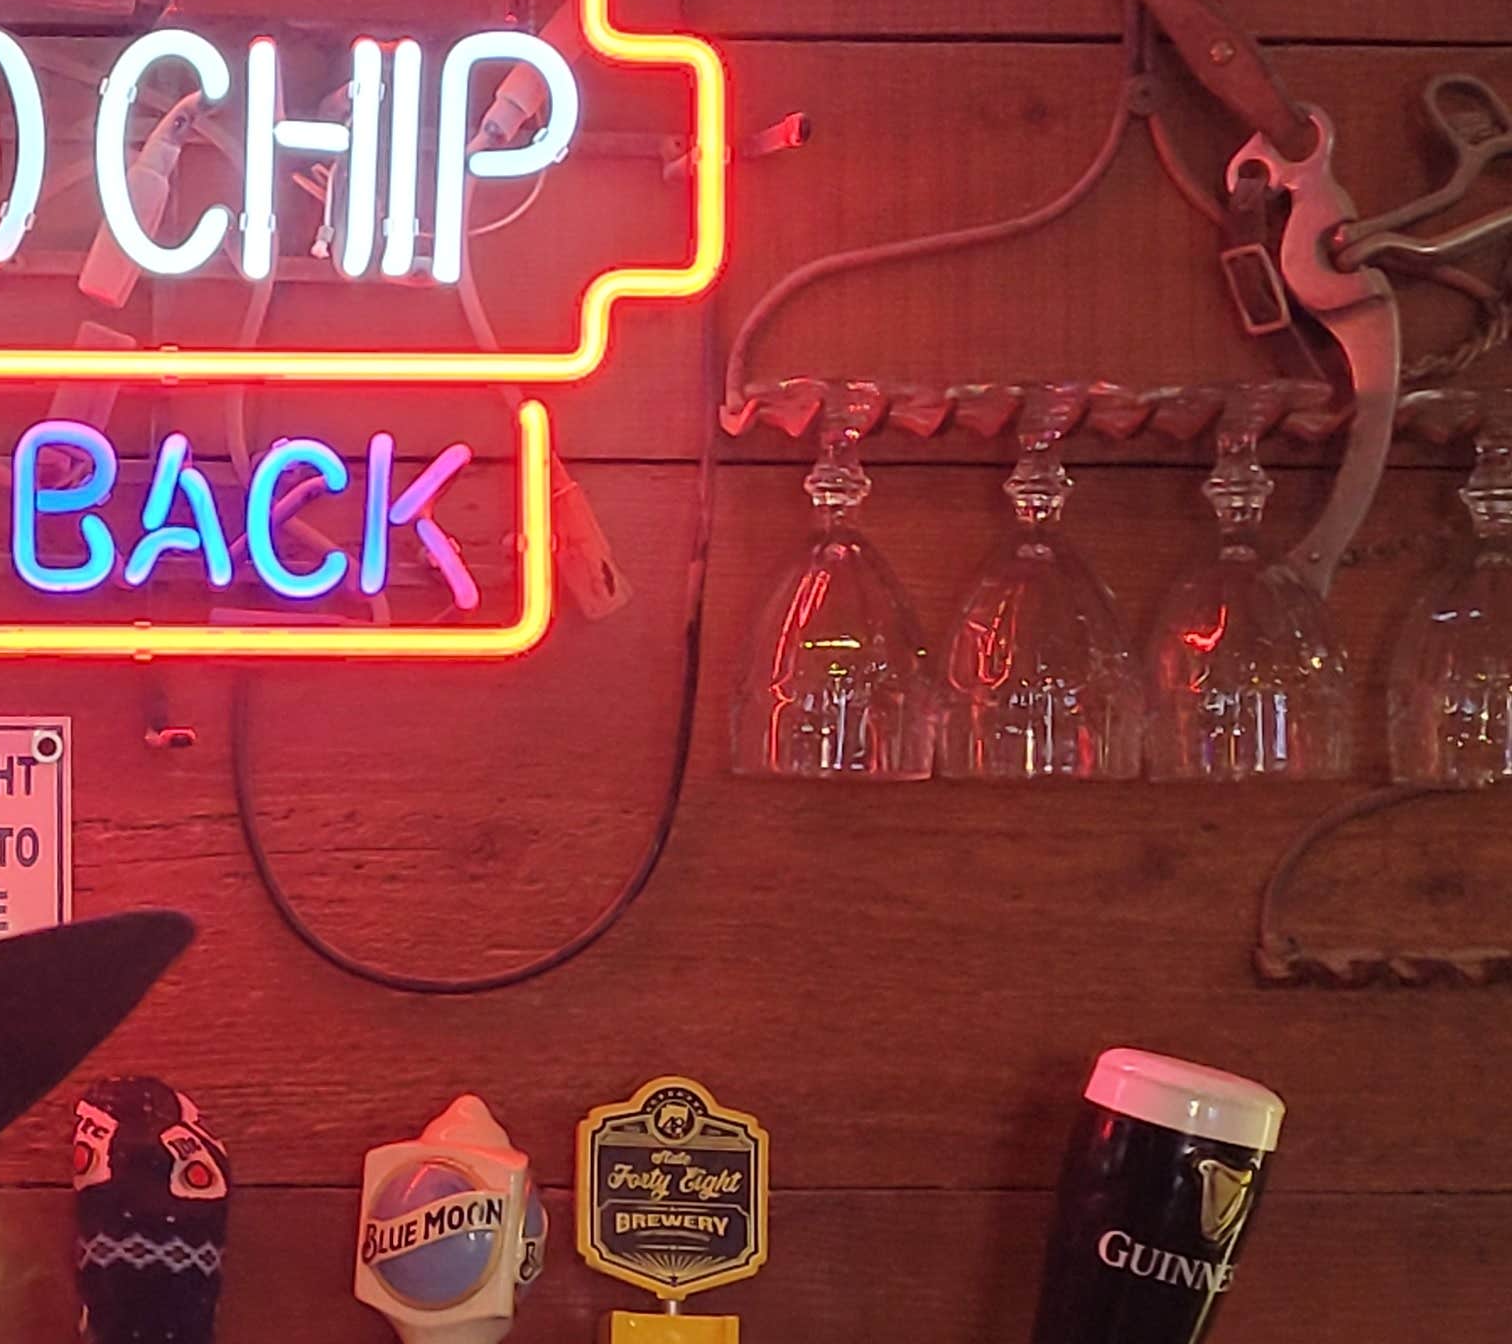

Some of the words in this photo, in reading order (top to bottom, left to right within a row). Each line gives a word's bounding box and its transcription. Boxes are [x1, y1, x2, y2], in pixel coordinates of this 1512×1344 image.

[96, 27, 580, 284] CHIP
[13, 420, 480, 609] BACK
[607, 1163, 673, 1201] Forty
[679, 1166, 743, 1201] Eight
[361, 1219, 418, 1264] BLUE
[423, 1198, 503, 1241] MOON
[614, 1212, 730, 1237] BREWERY
